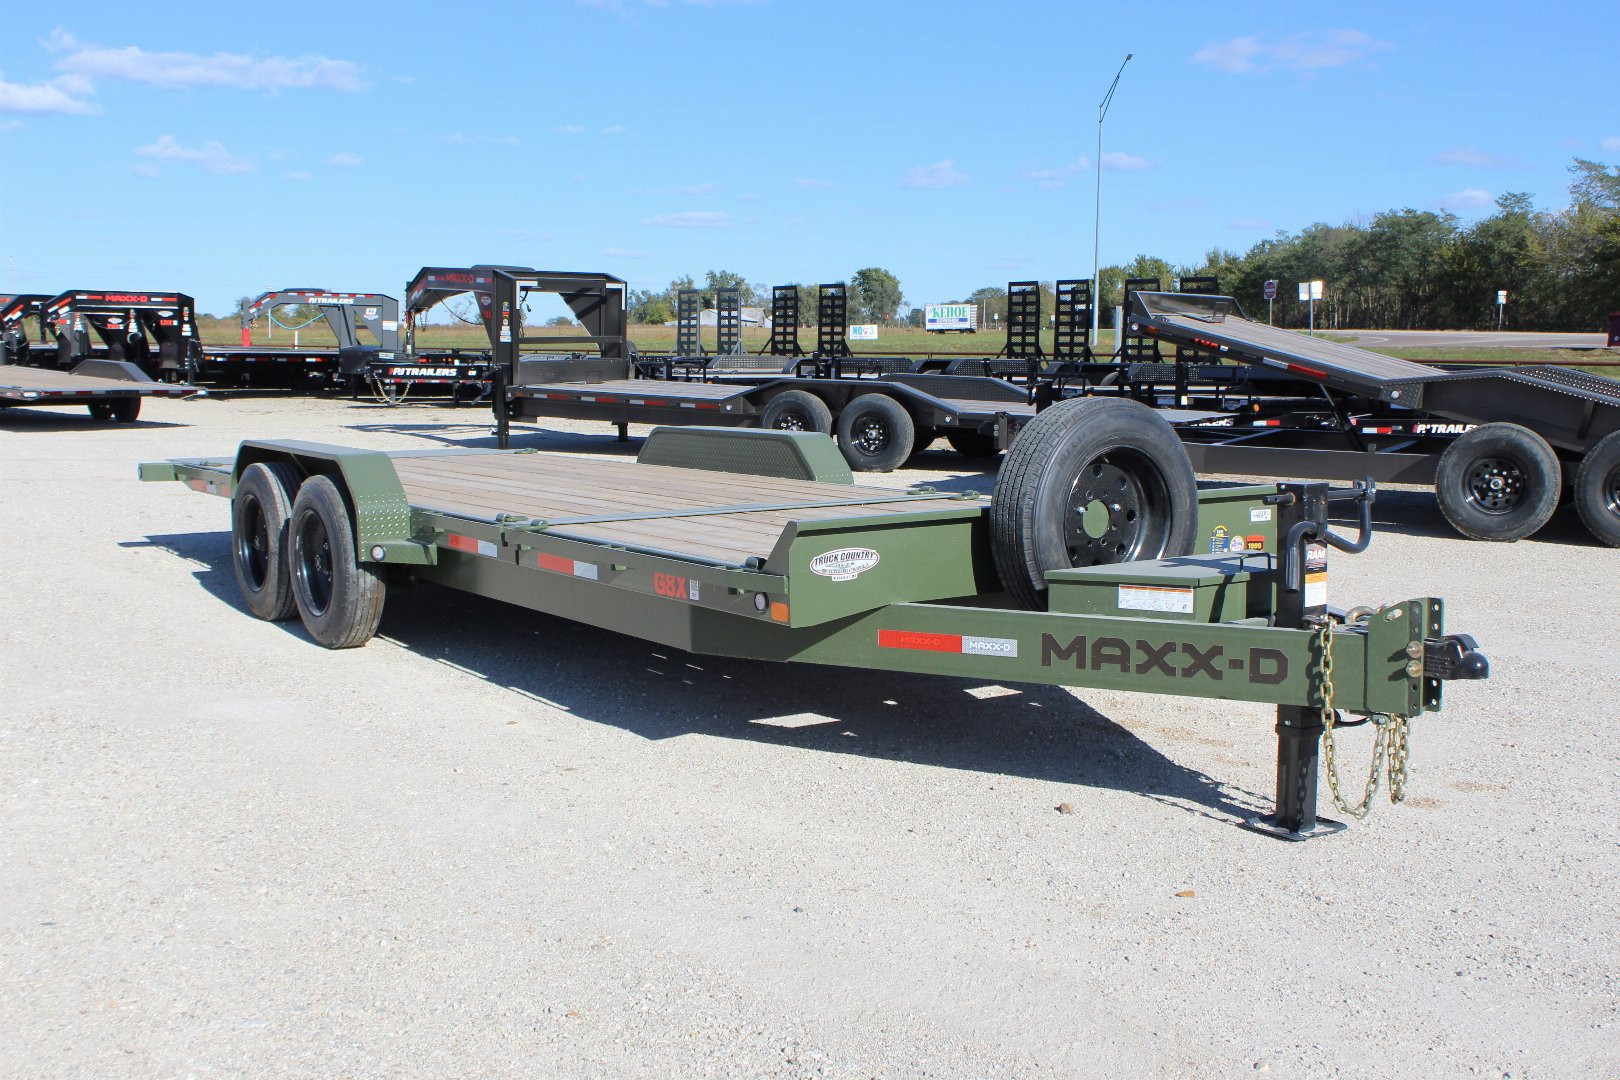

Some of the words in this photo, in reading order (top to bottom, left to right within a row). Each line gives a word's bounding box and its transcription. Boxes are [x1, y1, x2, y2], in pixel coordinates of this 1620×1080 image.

[105, 294, 148, 303] MAXX-D
[852, 326, 863, 335] NO
[814, 554, 840, 567] TRUCK
[840, 551, 875, 561] COUNTRY
[1306, 550, 1325, 560] RAM
[900, 636, 940, 646] MAXX-D
[969, 641, 1011, 652] MAXX-D
[1041, 632, 1289, 685] MAXX-D
